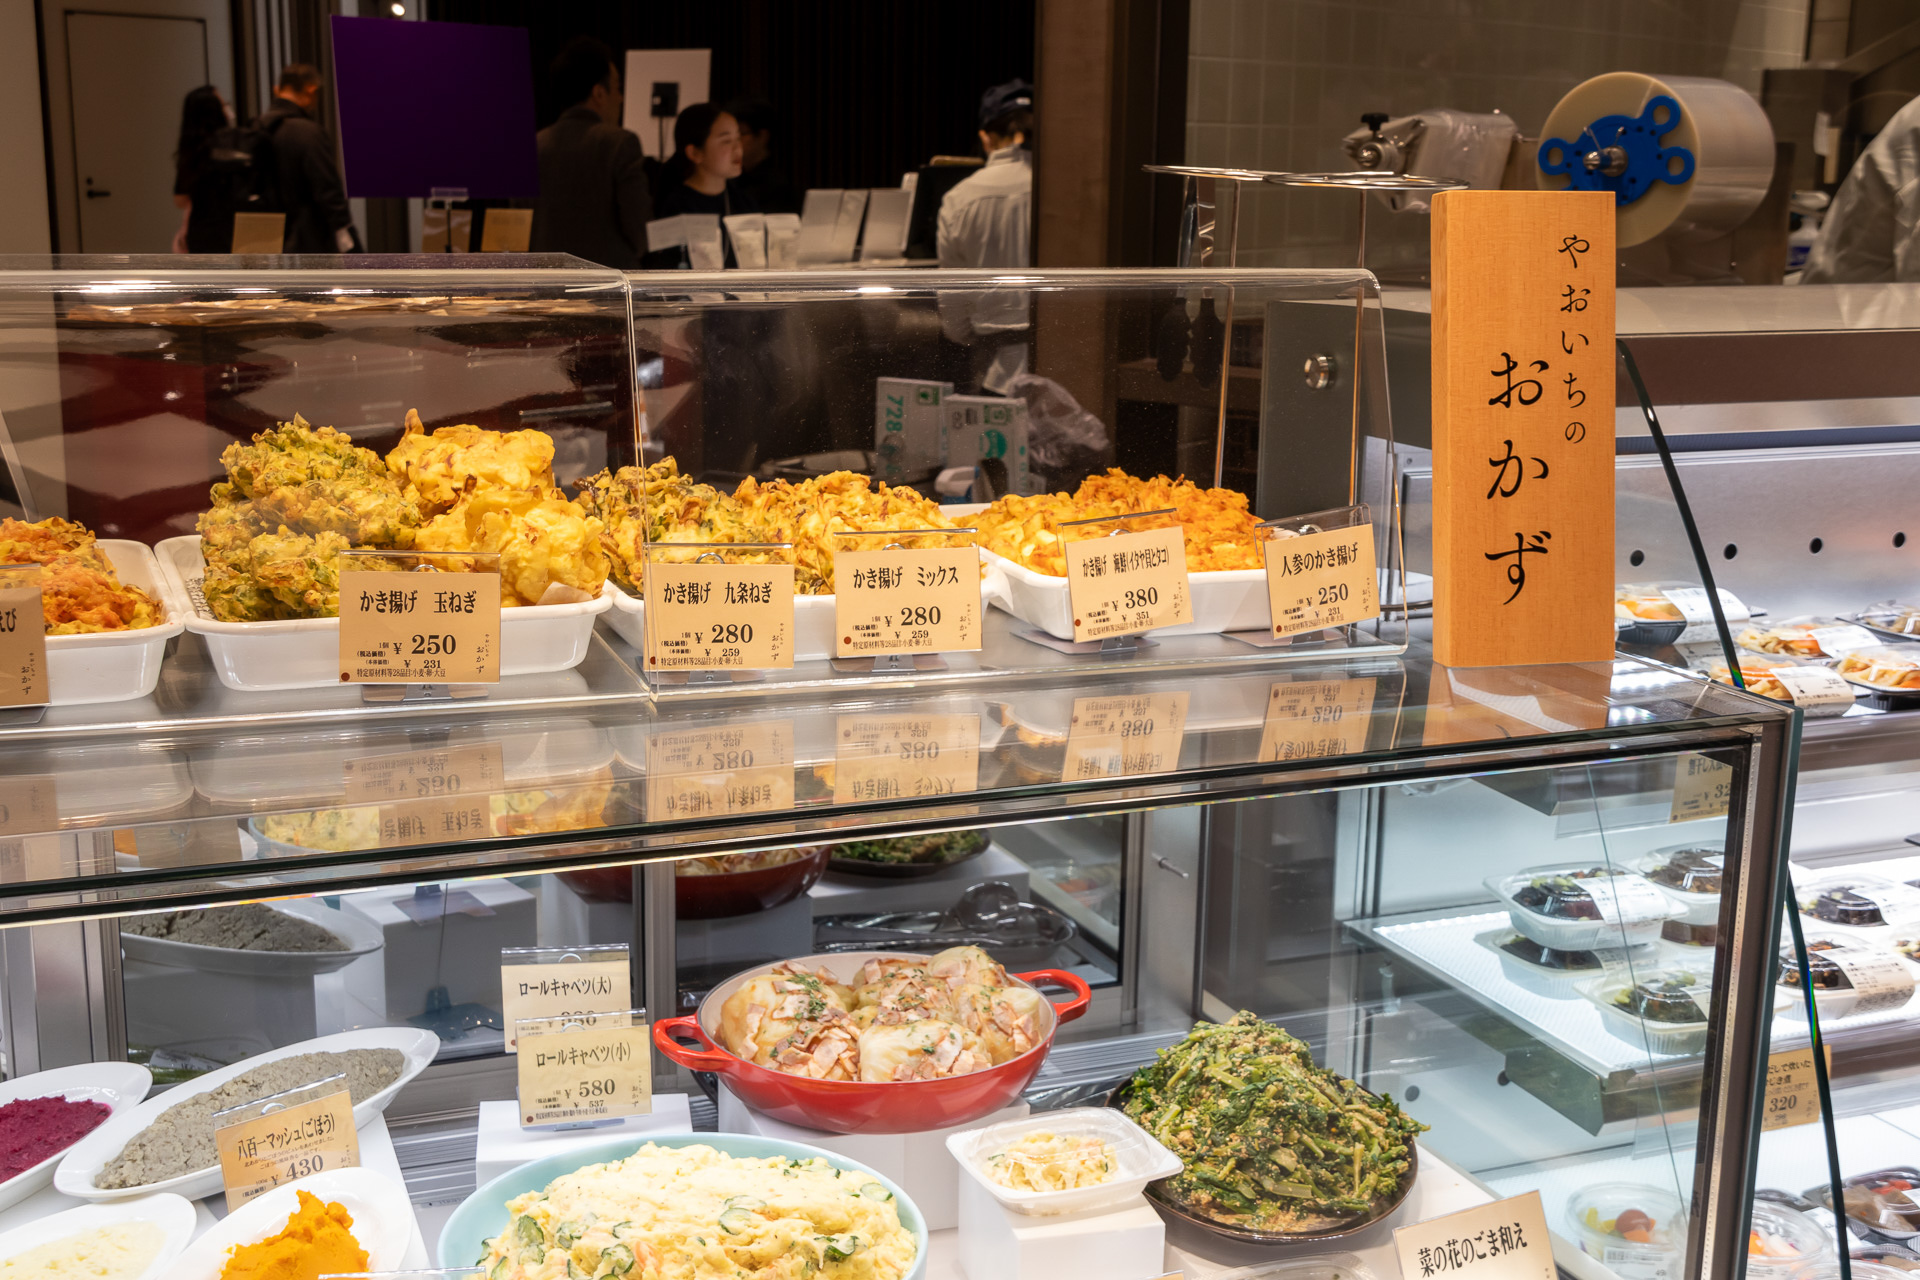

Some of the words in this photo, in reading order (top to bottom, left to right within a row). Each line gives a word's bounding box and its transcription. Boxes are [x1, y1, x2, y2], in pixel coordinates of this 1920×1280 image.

[1558, 234, 1591, 445] やおいちの
[885, 394, 904, 432] 728
[1484, 352, 1552, 606] おかず
[1082, 554, 1107, 578] かき揚げ
[1281, 542, 1358, 578] 人参のかき揚げ
[853, 566, 903, 589] かき揚げ
[917, 565, 959, 587] ミックス
[360, 590, 418, 613] かき揚げ
[433, 590, 477, 613] 玉ねぎ
[663, 581, 712, 604] かき揚げ
[724, 581, 773, 604] 九条ねぎ
[1125, 586, 1158, 609] 380
[1318, 583, 1349, 606] 250
[884, 615, 893, 627] ¥
[901, 606, 941, 626] 280
[1136, 611, 1150, 620] 351
[1328, 606, 1341, 616] 231
[393, 642, 402, 655] ¥
[411, 634, 456, 655] 250
[695, 632, 703, 644] ¥
[711, 624, 753, 643] 280
[911, 630, 929, 639] 259
[404, 659, 411, 668] ¥
[423, 659, 441, 669] 231
[476, 646, 485, 674] おかず
[722, 648, 740, 657] 259
[21, 666, 32, 695] おかず
[519, 976, 612, 996] ロールキャベツ(大)
[536, 1042, 631, 1067] ロールキャベツ(小)
[579, 1079, 615, 1097] 580
[589, 1100, 604, 1108] 537
[1769, 1095, 1797, 1112] 320
[238, 1112, 335, 1161] 八百一マッシュ(ごぼう)
[286, 1155, 324, 1180] 430
[1417, 1222, 1528, 1279] 菜の花のごま和え
